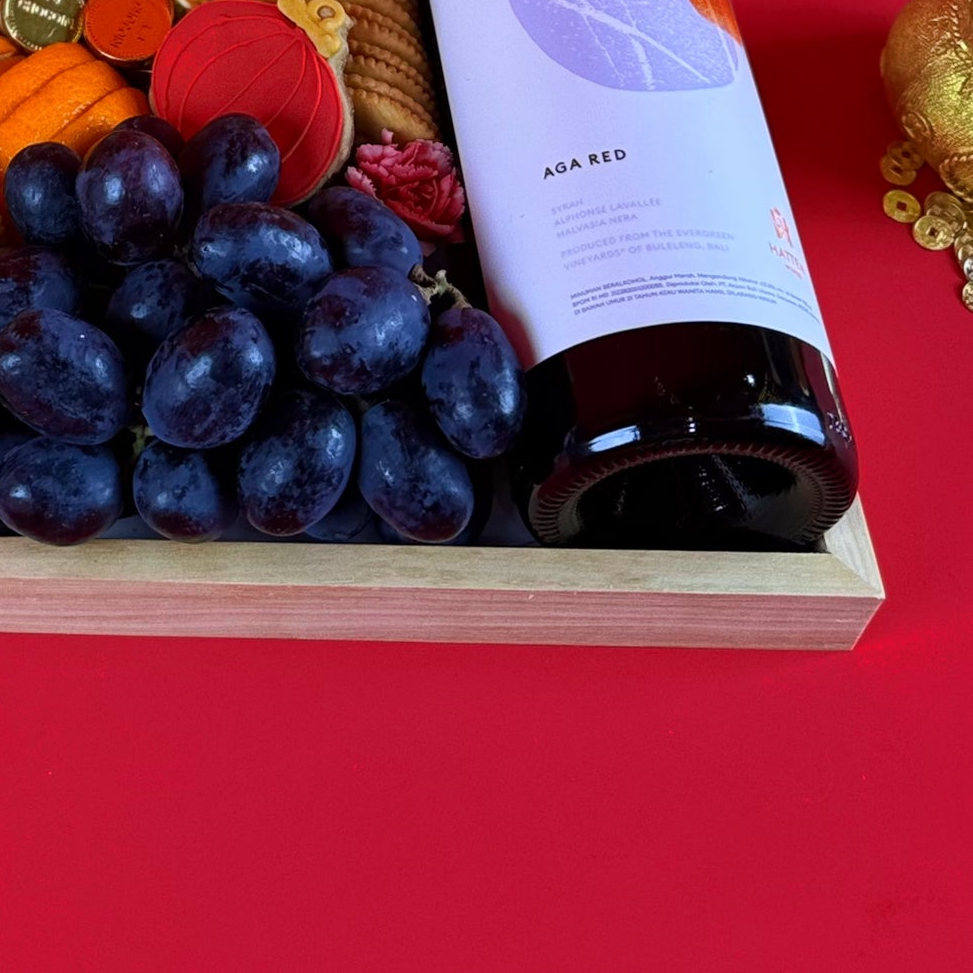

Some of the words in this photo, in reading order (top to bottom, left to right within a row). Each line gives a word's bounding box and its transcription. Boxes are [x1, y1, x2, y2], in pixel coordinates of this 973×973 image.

[543, 158, 582, 180] AGA
[588, 148, 627, 166] RED
[551, 199, 584, 215] SYRAH
[554, 205, 607, 227] ALPHONSE
[557, 219, 607, 239] MALVASIA
[609, 213, 639, 226] NERA
[561, 237, 616, 259] PRODUCED
[619, 232, 650, 243] FROM
[652, 229, 674, 238] THE
[677, 228, 735, 241] EVERGREEN
[627, 244, 644, 255] OF
